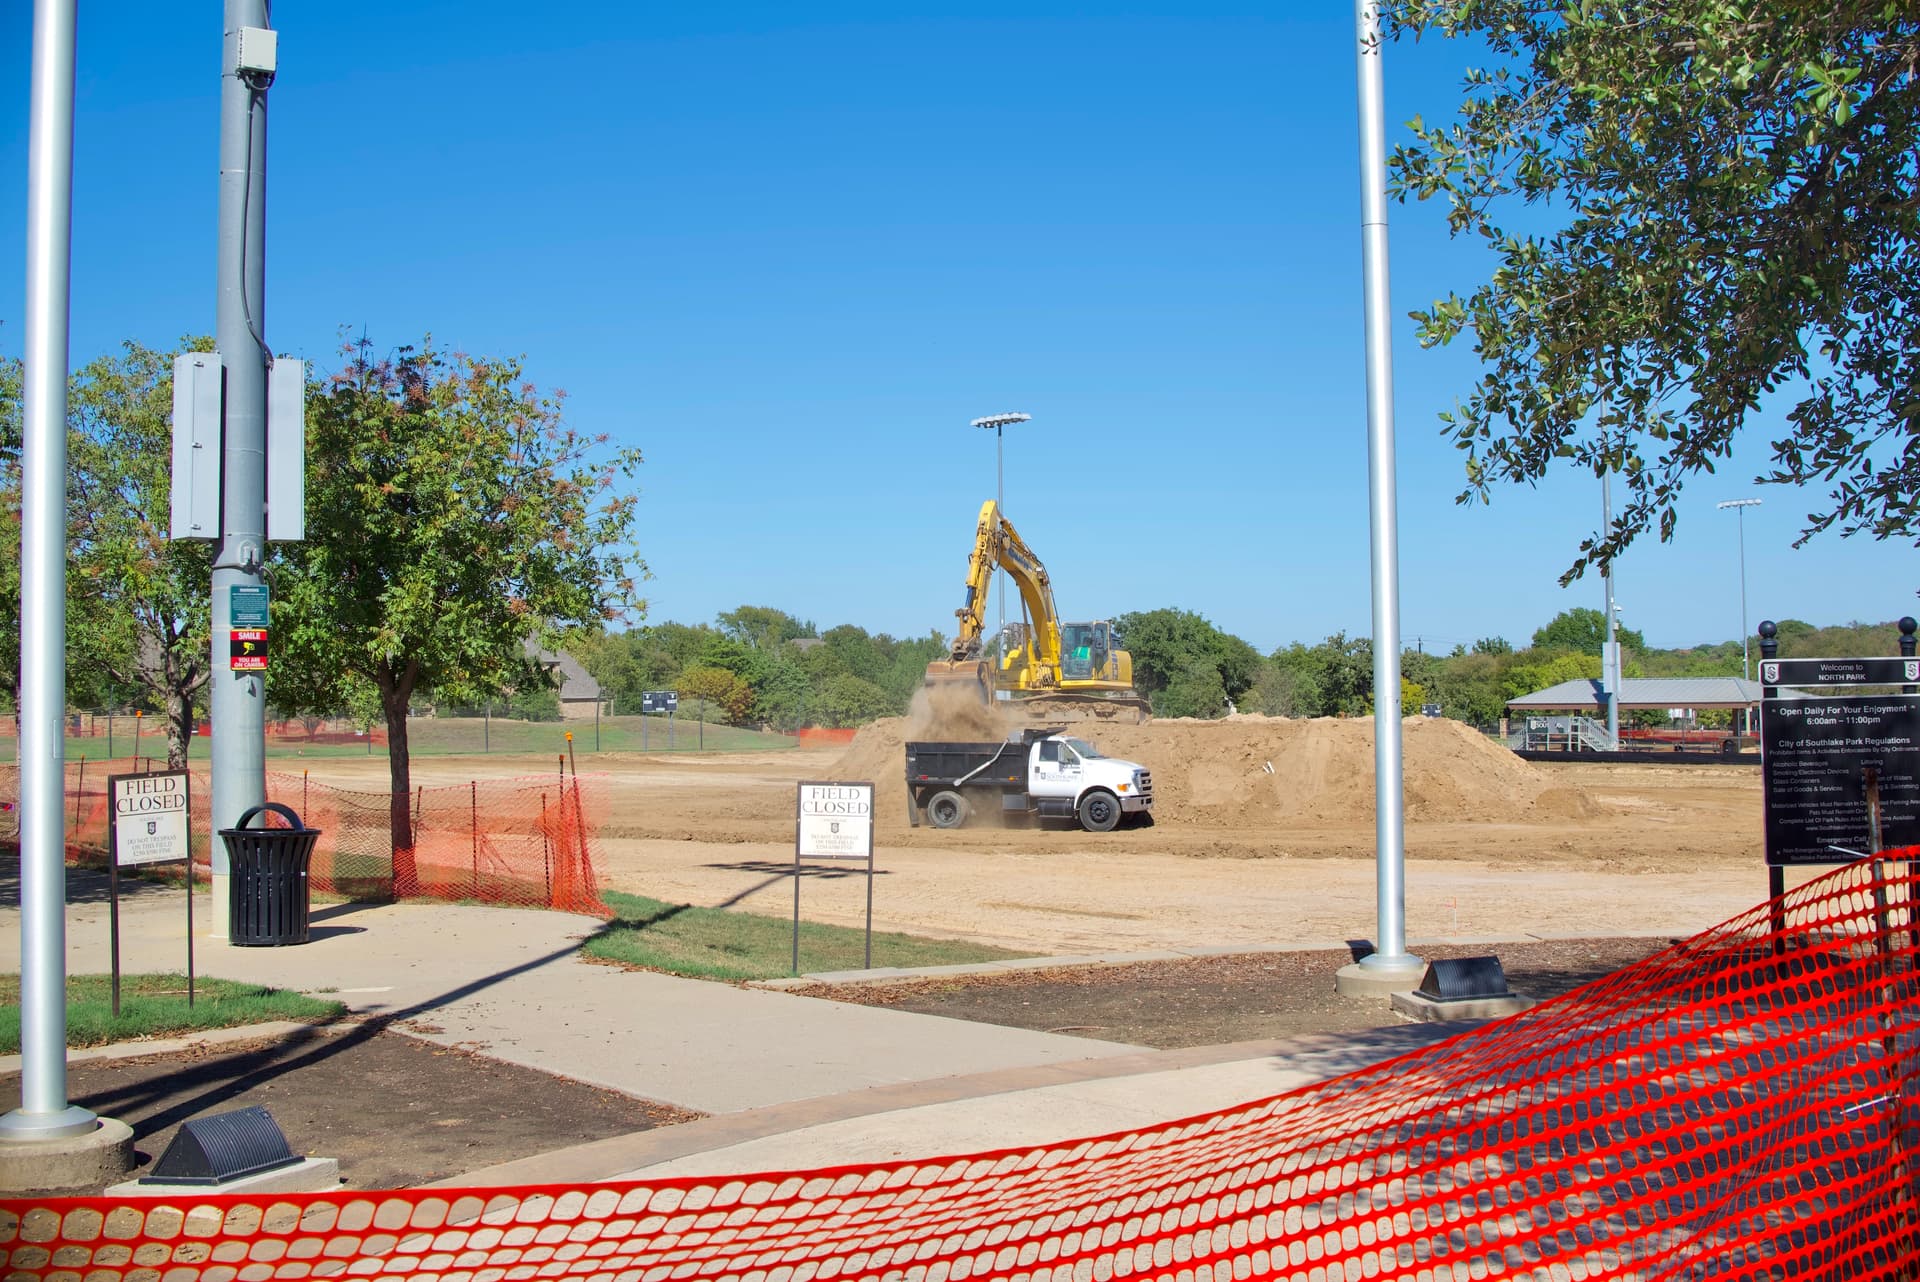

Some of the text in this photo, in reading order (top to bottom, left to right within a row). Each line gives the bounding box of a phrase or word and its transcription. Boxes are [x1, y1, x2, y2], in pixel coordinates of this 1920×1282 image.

[238, 632, 260, 640] SMILE
[1780, 708, 1802, 717] Open
[1804, 707, 1825, 716] Daily
[1843, 706, 1861, 714] Your
[1864, 705, 1907, 714] Enjoyment
[1846, 716, 1881, 725] 11:00pm
[1779, 740, 1794, 749] City
[1805, 738, 1844, 747] Southlake
[1845, 738, 1863, 746] Park
[1865, 737, 1910, 746] Regulations
[1880, 746, 1890, 754] City
[126, 777, 176, 795] FIELD
[812, 787, 860, 800] FIELD
[116, 793, 185, 813] CLOSED
[802, 801, 869, 814] CLOSED
[1817, 836, 1852, 845] Emergency
